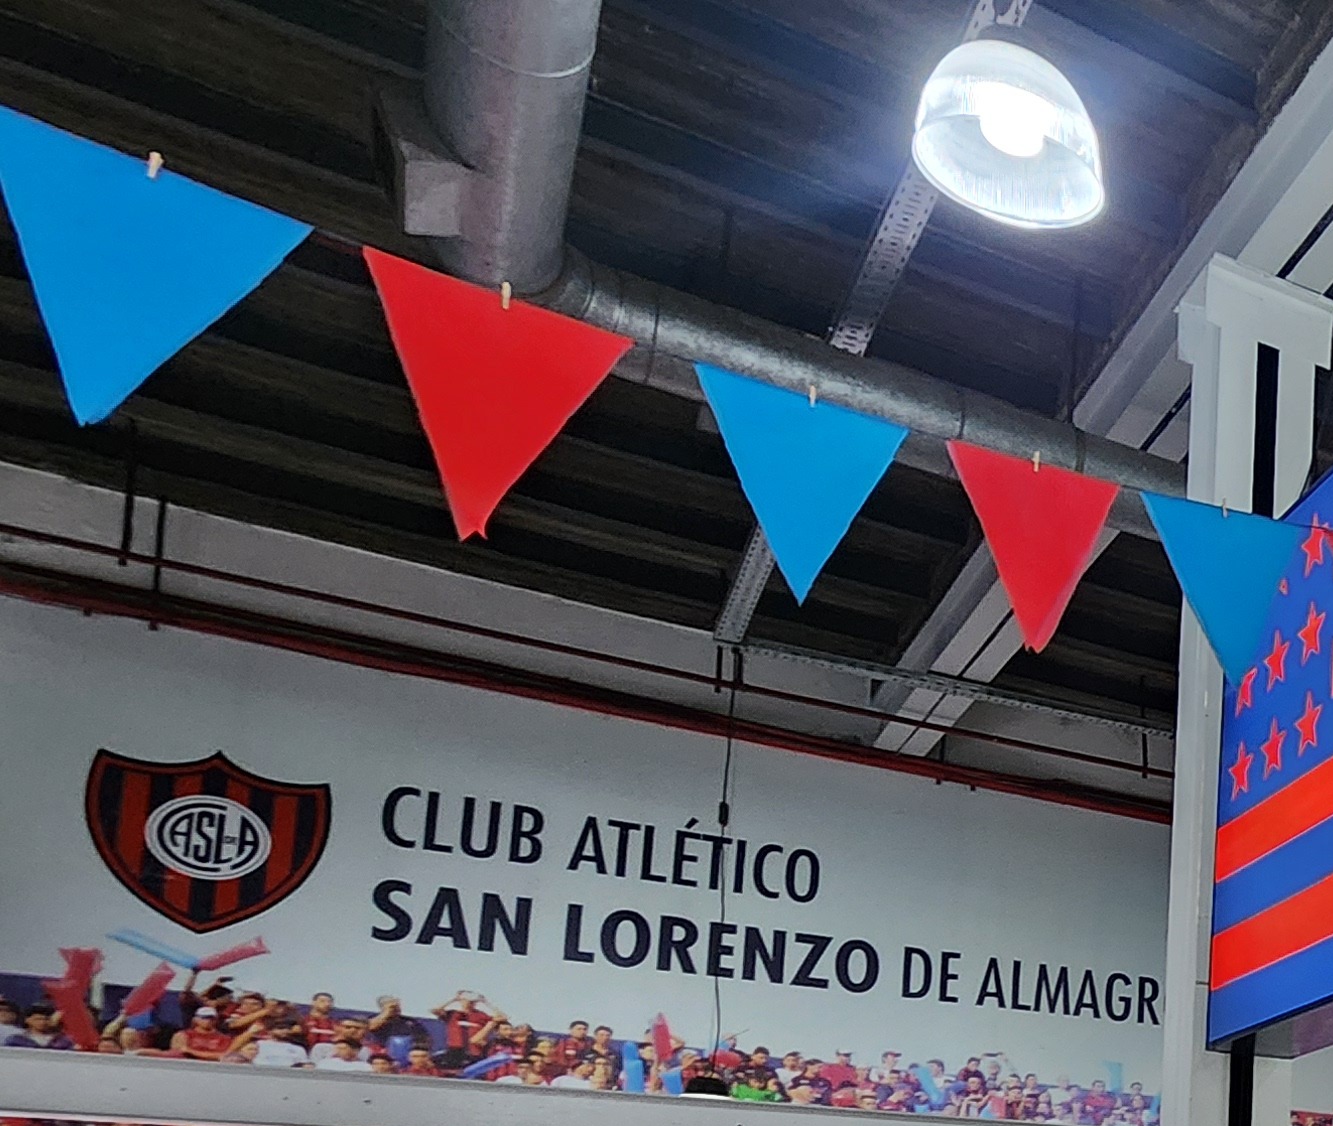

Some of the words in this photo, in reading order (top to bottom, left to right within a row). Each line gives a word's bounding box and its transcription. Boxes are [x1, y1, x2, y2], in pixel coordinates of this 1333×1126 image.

[381, 786, 544, 865] CLUB
[568, 810, 821, 903] ATLÉTICO
[371, 880, 533, 955] SAN
[563, 904, 881, 993] LORENZO
[901, 946, 962, 1005] DE
[976, 957, 1161, 1026] ALMAGR
